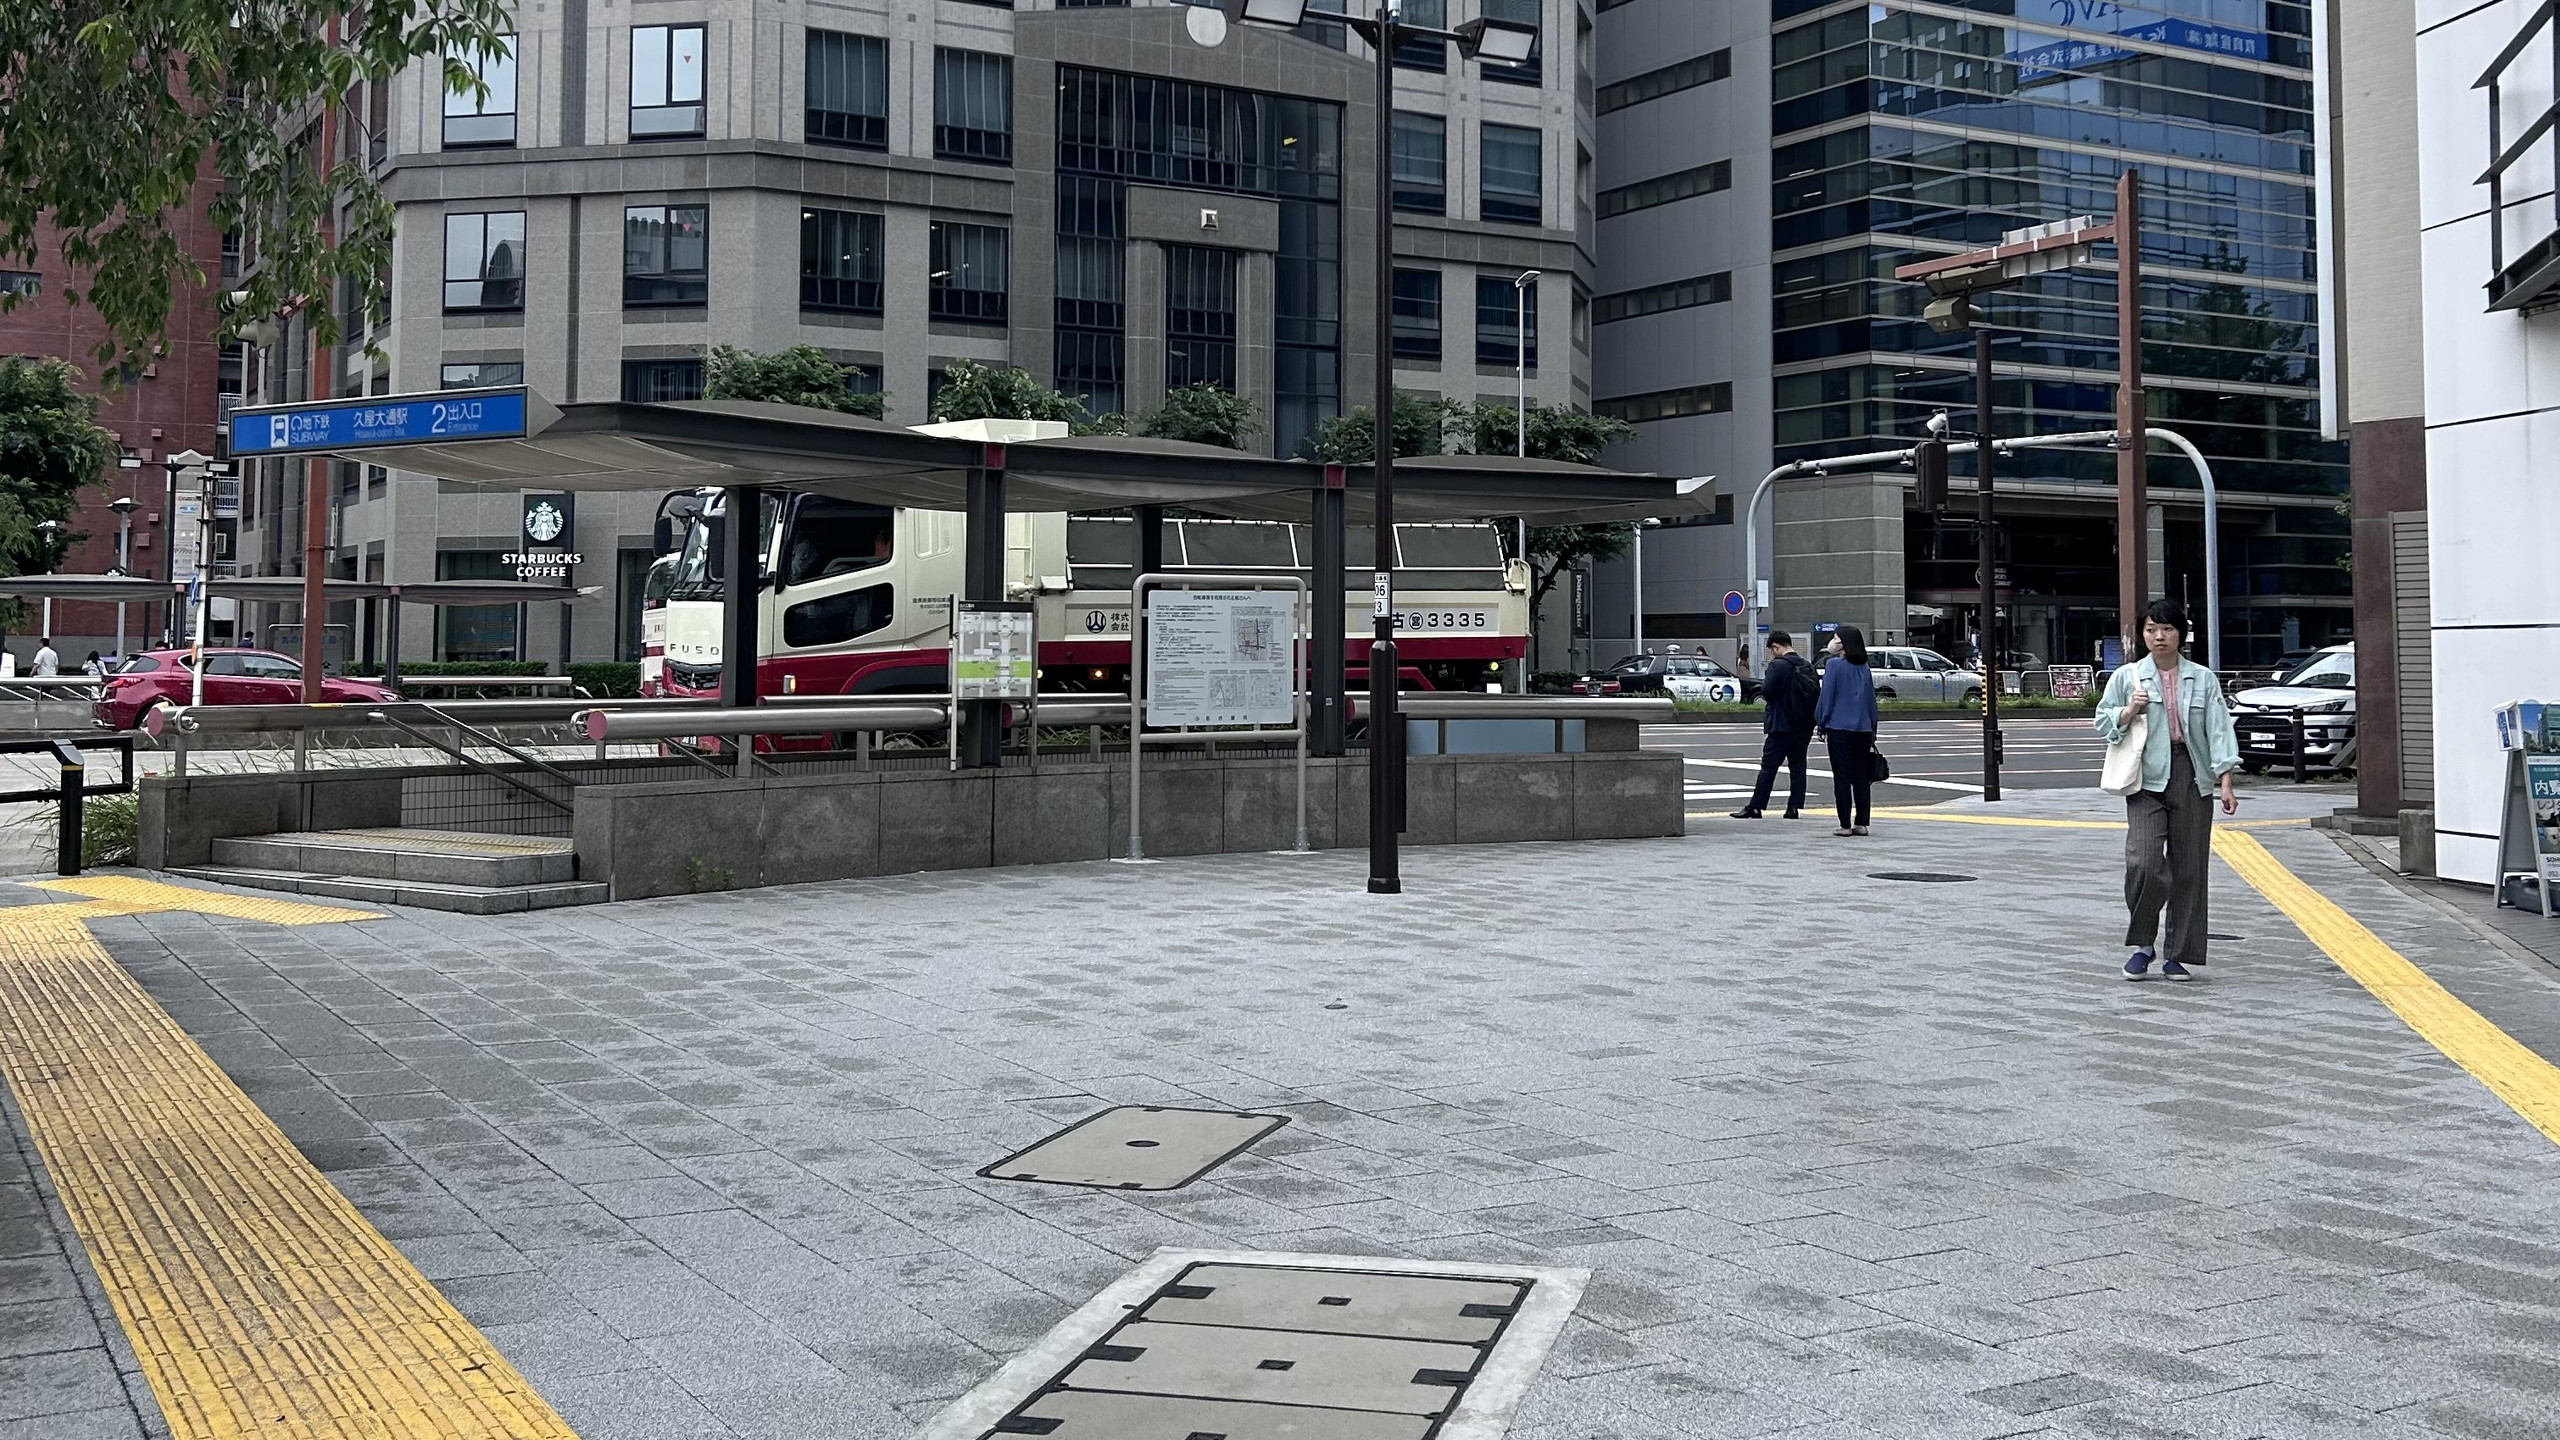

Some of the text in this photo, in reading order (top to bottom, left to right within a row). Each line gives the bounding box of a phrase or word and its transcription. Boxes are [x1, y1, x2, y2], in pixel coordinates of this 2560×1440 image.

[303, 414, 330, 430] 地下鉄
[353, 407, 408, 427] 久屋大通駅
[432, 402, 482, 433] 2 出入口
[290, 430, 330, 443] SUBWAY
[502, 553, 581, 564] STARBUCKS
[517, 566, 566, 577] COFFEE
[1110, 612, 1130, 622] 株式
[1427, 612, 1485, 627] 3335
[1110, 622, 1130, 632] 会社
[669, 643, 720, 656] FUSO
